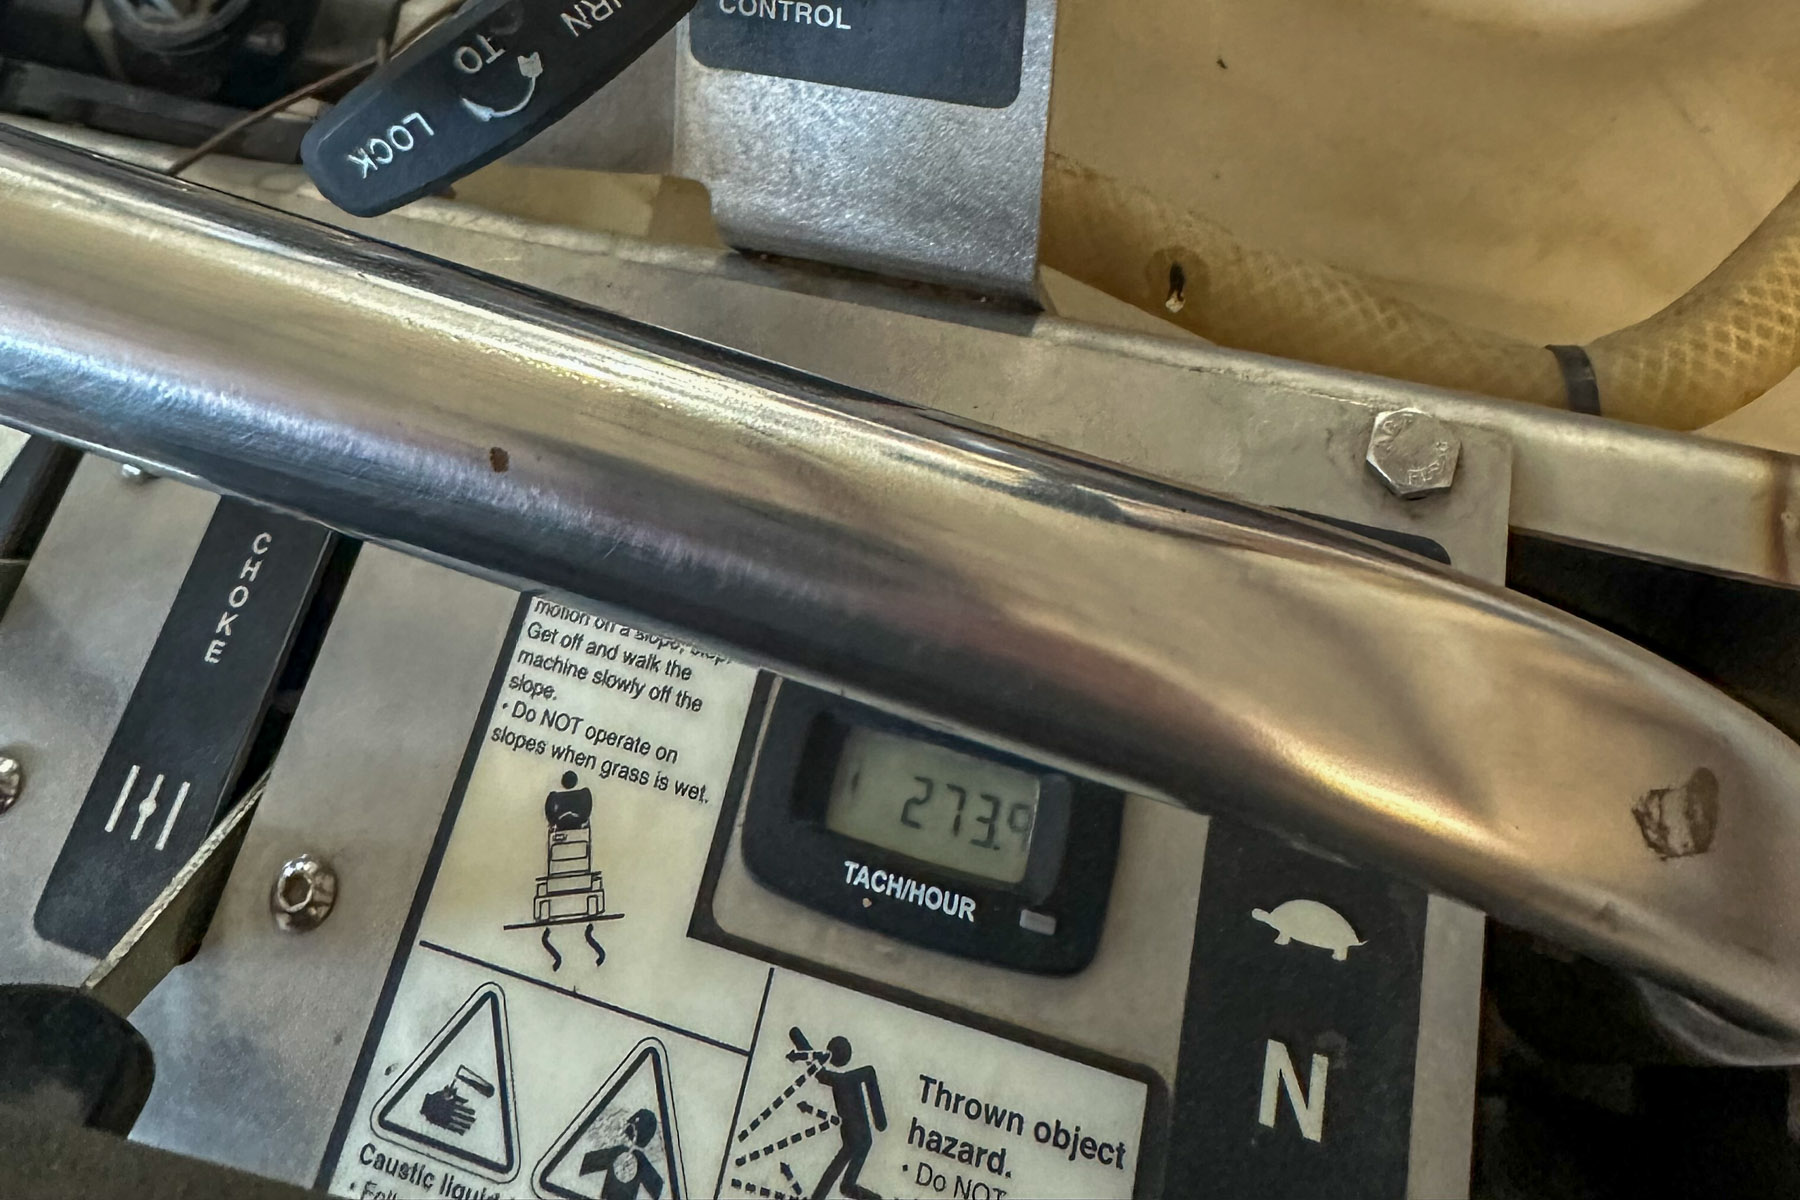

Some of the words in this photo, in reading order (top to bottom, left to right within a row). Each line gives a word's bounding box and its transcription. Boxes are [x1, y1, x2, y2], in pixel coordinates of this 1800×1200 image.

[453, 34, 507, 75] TO
[346, 111, 435, 179] LOCK
[203, 532, 272, 664] CHOKE
[517, 649, 589, 680] machine
[592, 668, 645, 700] slowly
[649, 684, 673, 704] off
[675, 691, 703, 713] the
[527, 621, 559, 645] Get
[560, 632, 584, 651] off
[585, 641, 620, 661] and
[623, 650, 662, 674] walk
[665, 659, 692, 681] the
[509, 674, 557, 701] slope.
[511, 700, 537, 723] Do
[540, 709, 584, 734] NOT
[585, 724, 651, 757] operate
[655, 745, 678, 764] on
[491, 725, 547, 756] slopes
[551, 743, 597, 770] when
[599, 759, 649, 785] grass
[653, 770, 669, 791] is
[674, 781, 709, 804] wet.
[844, 860, 976, 922] TACH/HOUR
[1257, 1038, 1329, 1143] N
[907, 1117, 1012, 1179] hazard.
[919, 1074, 1024, 1137] Thrown
[1034, 1119, 1127, 1171] object
[359, 1143, 435, 1190] Caustic
[915, 1162, 947, 1192] Do
